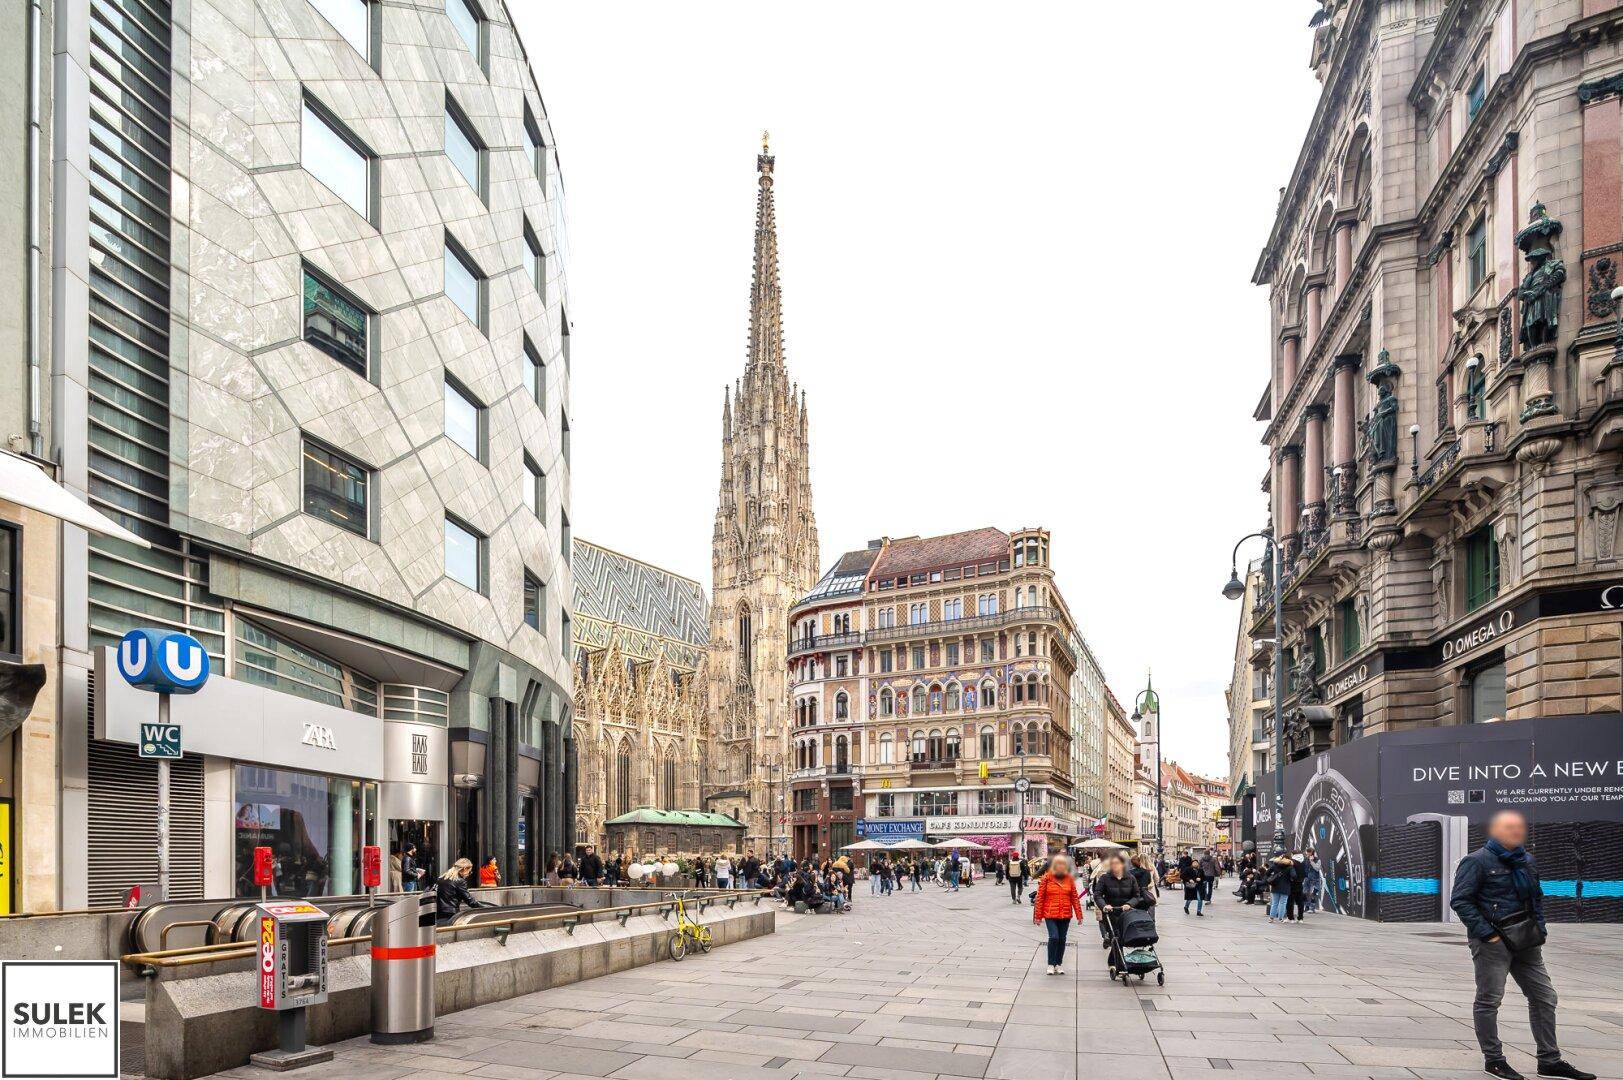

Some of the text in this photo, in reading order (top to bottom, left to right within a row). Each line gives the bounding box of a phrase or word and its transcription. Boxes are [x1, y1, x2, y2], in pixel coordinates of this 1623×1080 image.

[1455, 622, 1496, 653] OMEGA
[122, 637, 147, 677] U
[165, 640, 202, 681] U
[1335, 674, 1358, 695] OMEGA
[143, 725, 179, 742] WC
[301, 722, 338, 751] ZARA
[412, 734, 428, 753] HAAS
[412, 754, 428, 773] HAUS
[1413, 766, 1460, 782] DIVE
[1468, 764, 1521, 780] INTO
[1529, 763, 1547, 778] A
[1554, 760, 1609, 777] NEW
[1496, 788, 1508, 796] WE
[1528, 787, 1573, 795] CURRENTLY
[865, 823, 888, 833] MONEY
[888, 822, 924, 833] EXCHANGE
[262, 917, 274, 973] oe24
